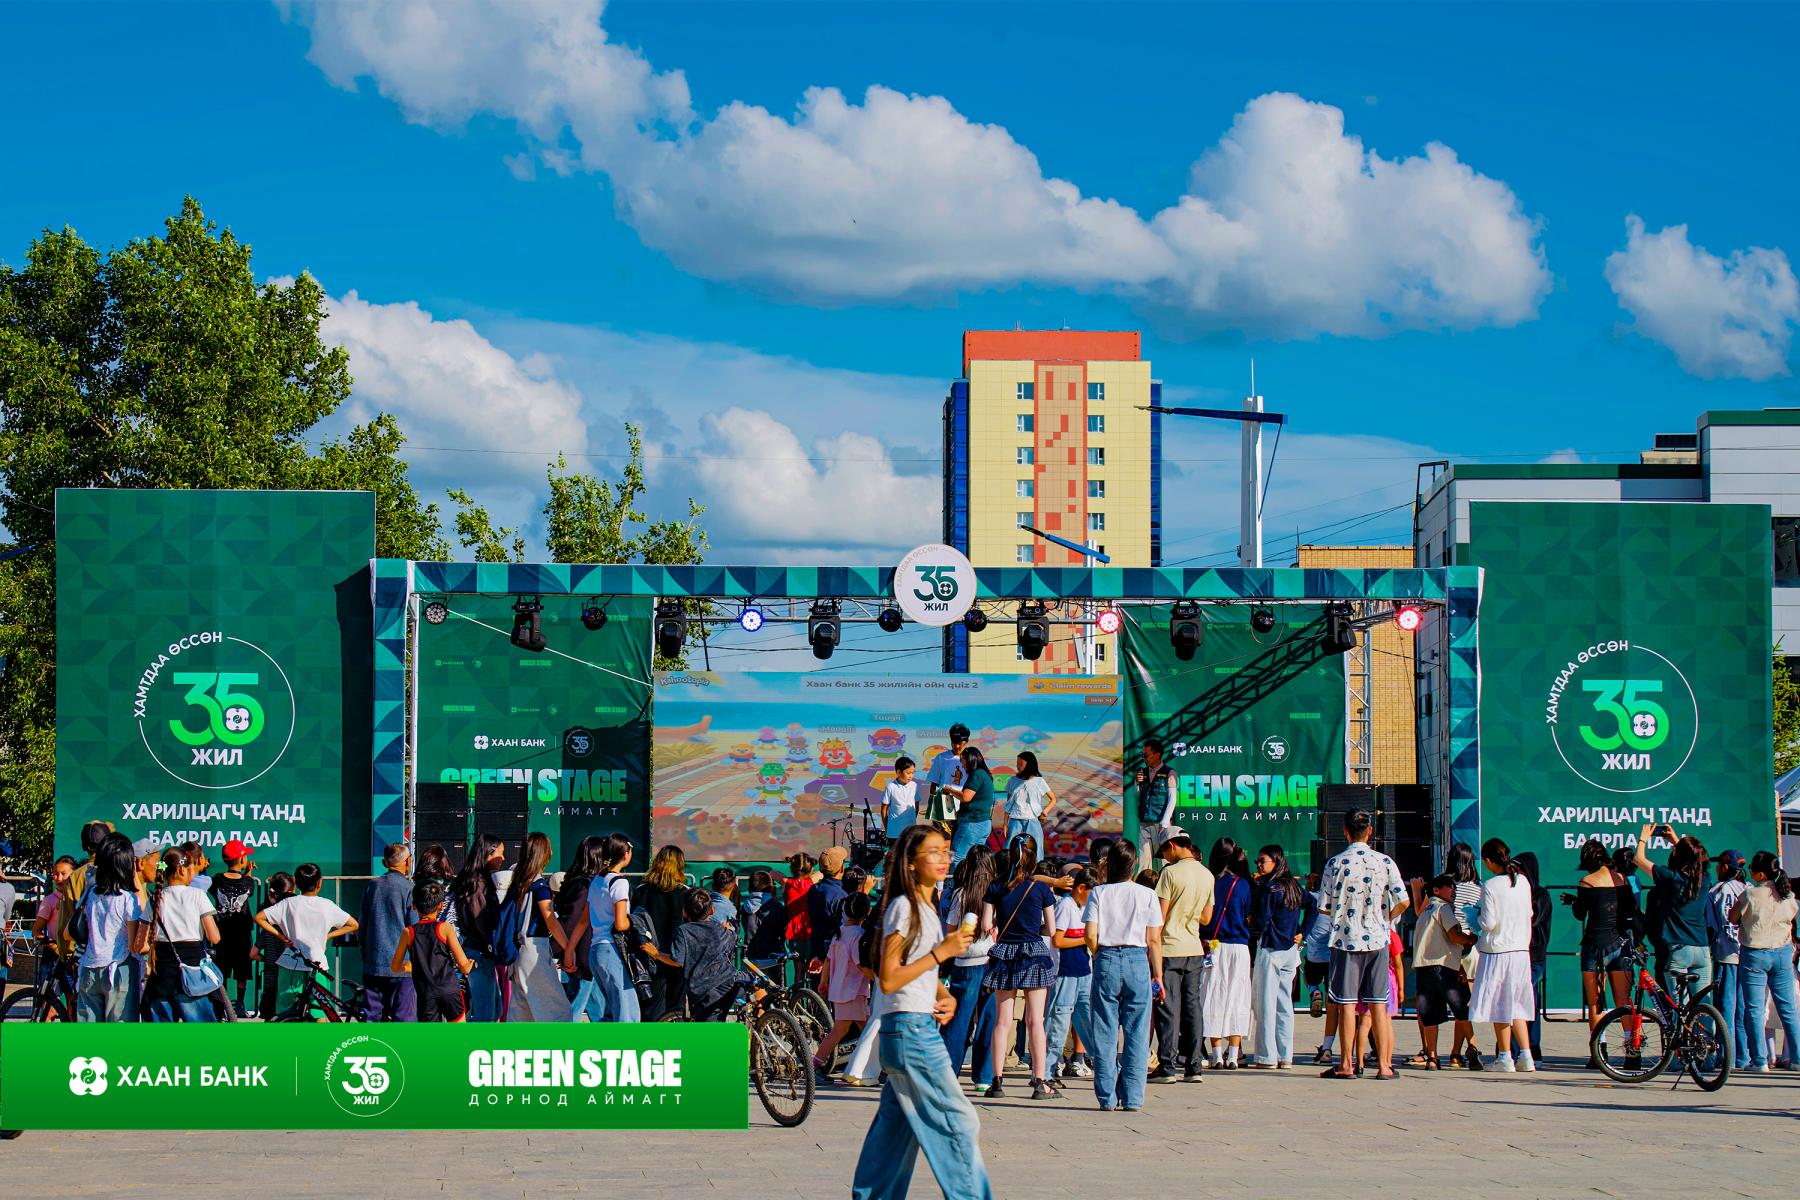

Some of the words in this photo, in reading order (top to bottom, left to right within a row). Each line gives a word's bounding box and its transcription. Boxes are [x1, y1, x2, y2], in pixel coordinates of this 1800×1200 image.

[913, 566, 958, 601] 35
[924, 603, 948, 611] ЖИЛ
[134, 654, 170, 718] ХАМТДАА
[169, 632, 222, 655] ӨССӨН
[1546, 662, 1579, 724] ХАМТДАА
[1578, 640, 1628, 663] ӨССӨН
[806, 680, 832, 688] Хаан
[835, 680, 861, 688] банк
[878, 680, 922, 689] жилийн
[924, 681, 945, 689] ойн
[948, 682, 970, 690] quiz
[169, 672, 264, 746] 35
[1579, 680, 1669, 750] 35
[491, 738, 518, 747] ХААН
[521, 738, 545, 747] БАНК
[571, 736, 589, 750] 35
[1189, 745, 1216, 754] ХААН
[1218, 745, 1242, 754] БАНК
[1267, 742, 1285, 756] 35
[191, 749, 243, 766] ЖИЛ
[1602, 753, 1651, 770] ЖИЛ
[538, 768, 627, 803] STAGE
[1176, 774, 1231, 808] EEN
[1235, 774, 1322, 808] STAGE
[122, 803, 245, 822] ХАРИЛЦАГЧ
[250, 804, 305, 823] ТАНД
[543, 806, 617, 816] АЙМАГТ
[1179, 812, 1227, 821] РНОД
[1241, 811, 1315, 821] АЙМАГТ
[1538, 807, 1654, 825] ХАРИЛЦАГЧ
[1658, 807, 1711, 826] ТАНД
